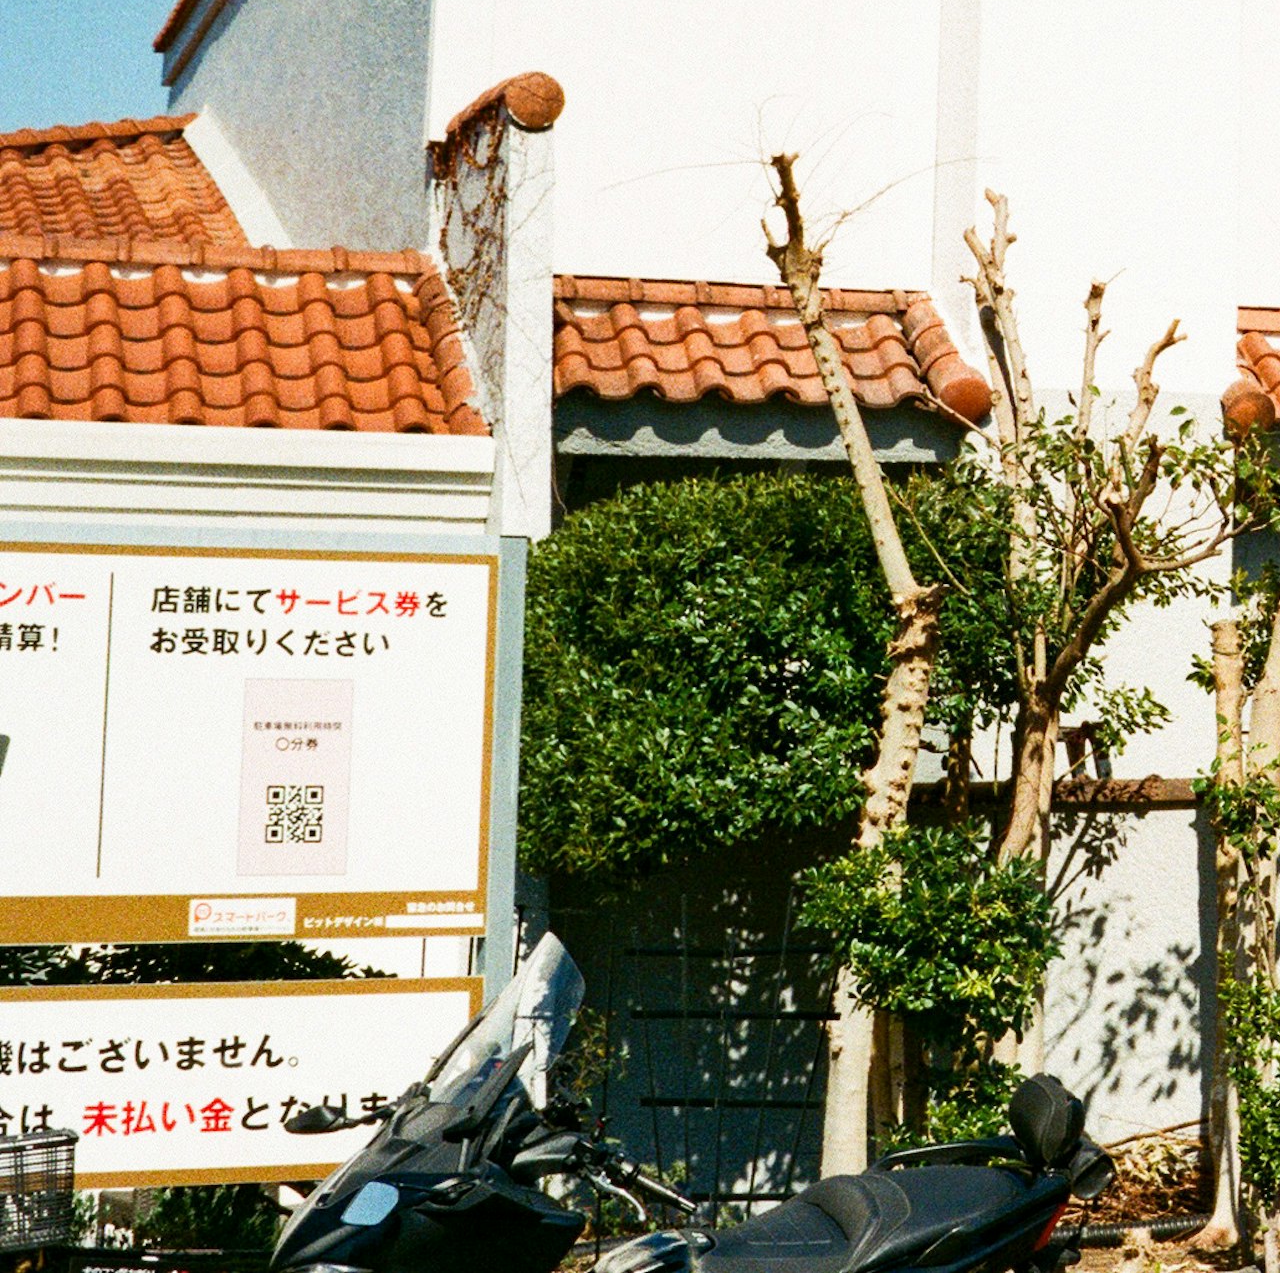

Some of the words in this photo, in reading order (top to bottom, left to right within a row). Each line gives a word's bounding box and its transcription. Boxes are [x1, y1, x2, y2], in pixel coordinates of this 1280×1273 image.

[151, 586, 448, 618] 店舗にてサービス券を
[150, 627, 390, 658] お受取りください
